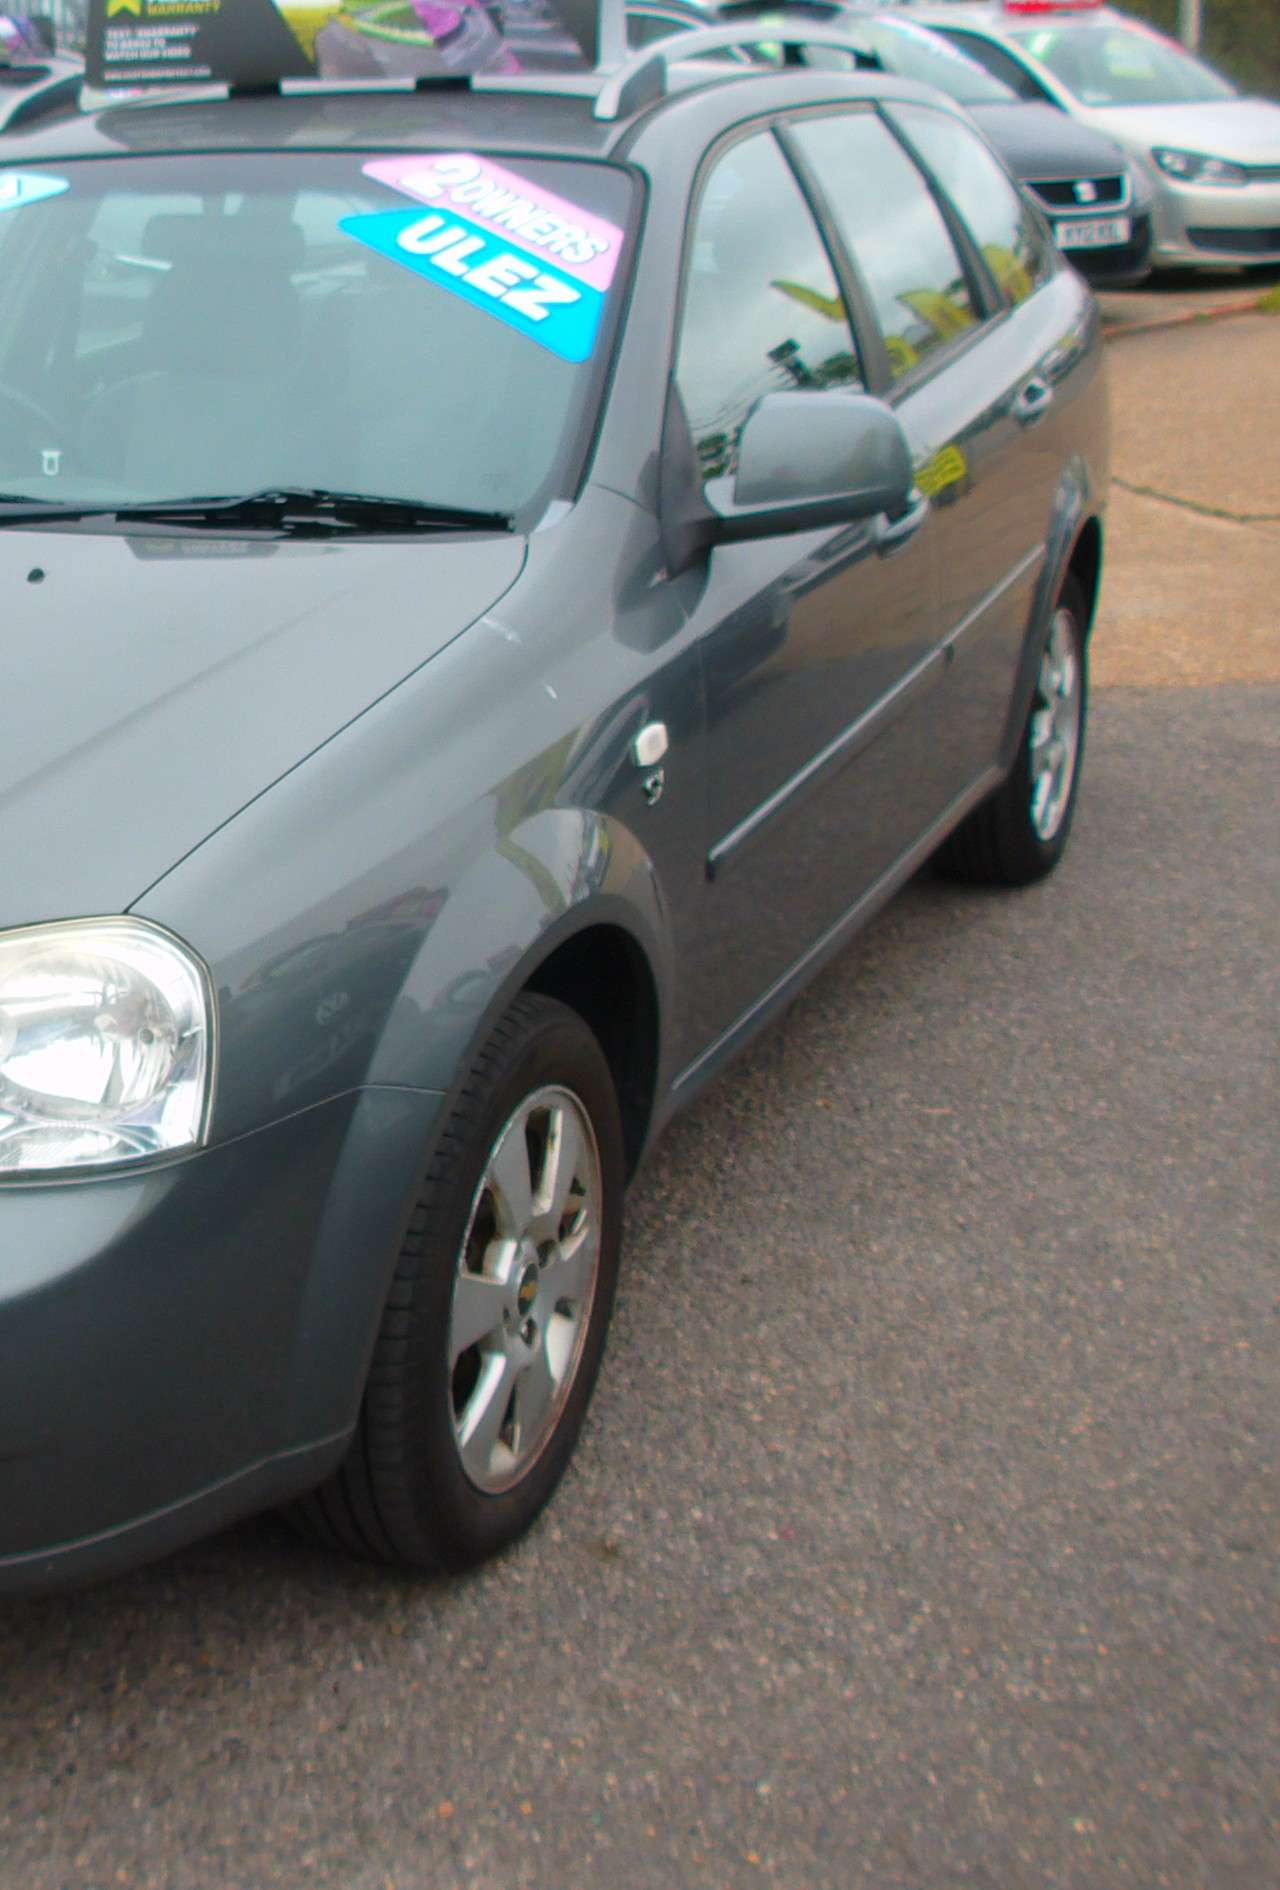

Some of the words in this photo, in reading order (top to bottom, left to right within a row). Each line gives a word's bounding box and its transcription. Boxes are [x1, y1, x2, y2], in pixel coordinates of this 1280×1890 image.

[399, 158, 482, 199] 2
[449, 181, 611, 265] OWNERS
[397, 214, 582, 321] ULEZ
